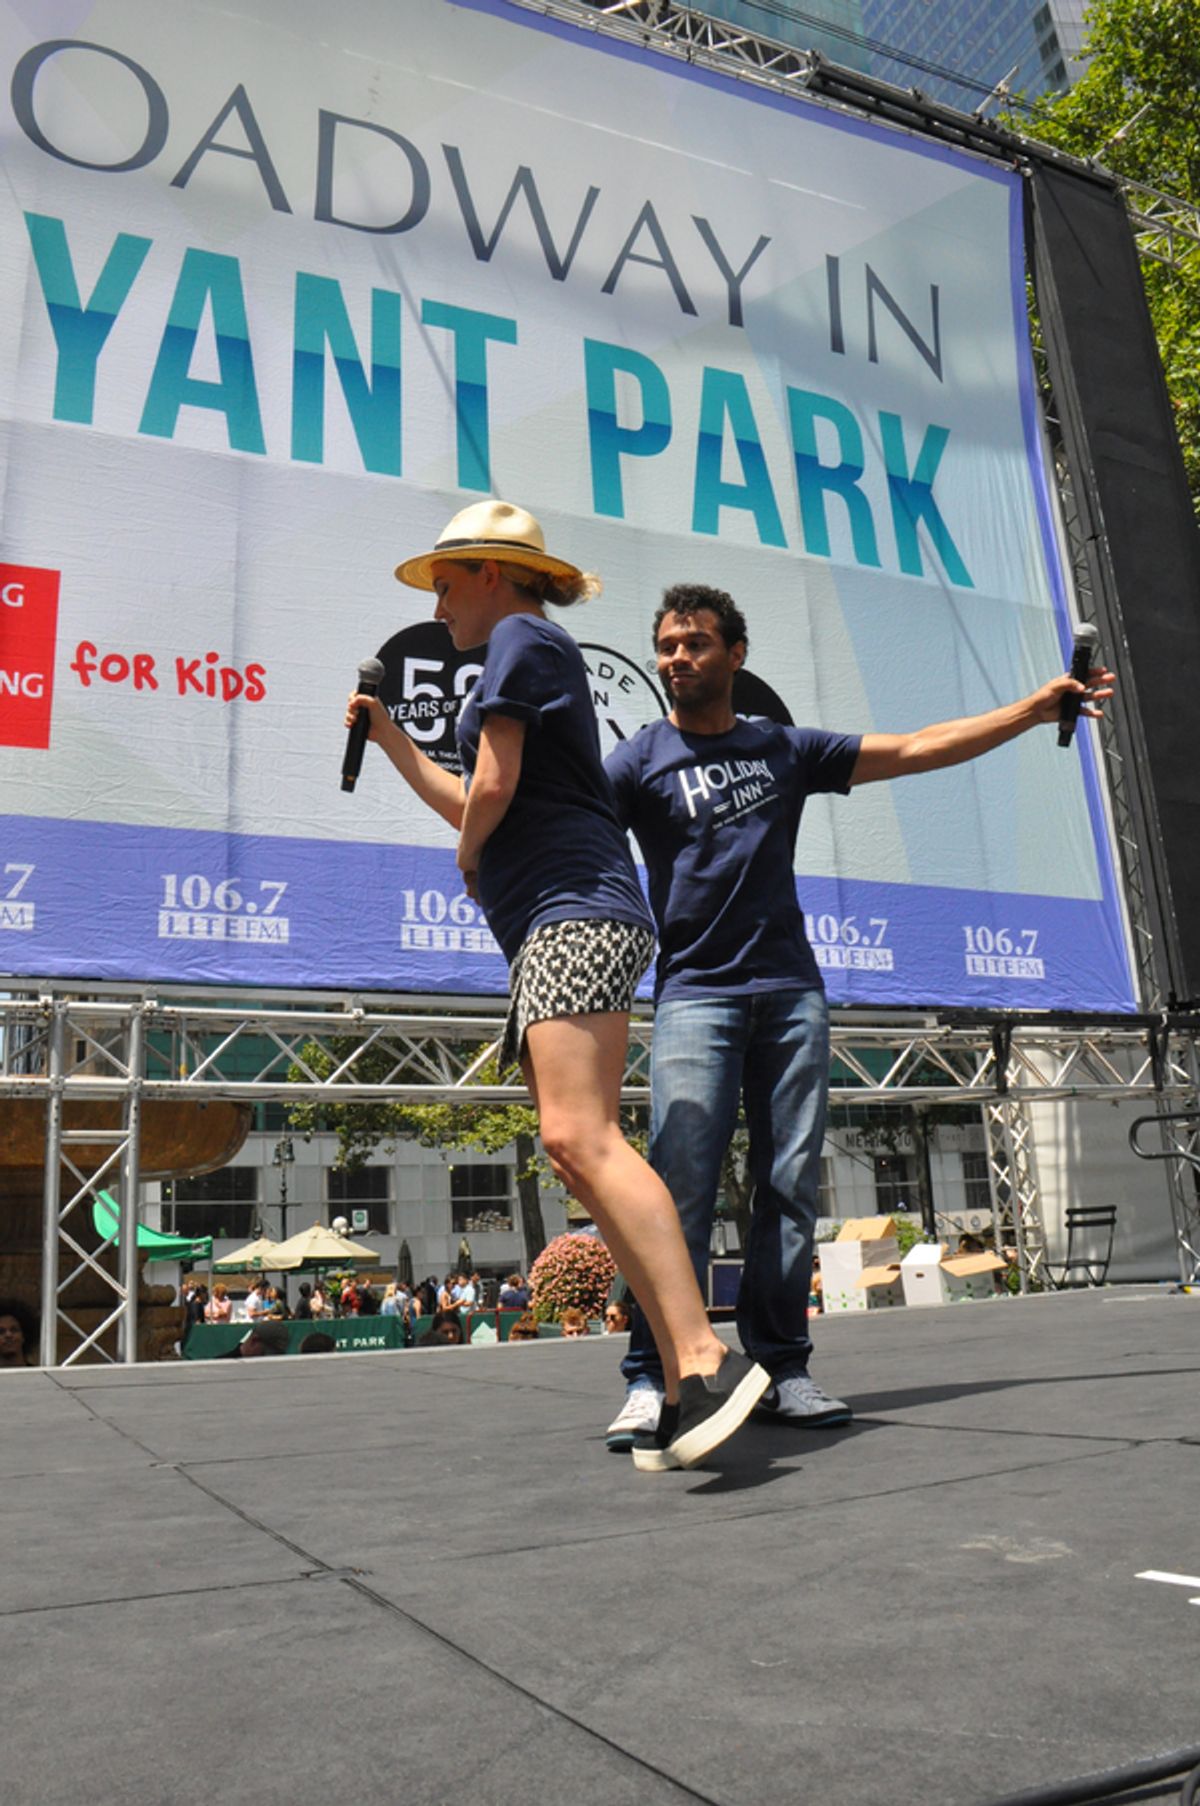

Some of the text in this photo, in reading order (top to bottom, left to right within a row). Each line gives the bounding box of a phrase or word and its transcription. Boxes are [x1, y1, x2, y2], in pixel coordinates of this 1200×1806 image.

[10, 39, 943, 384] OADWAY IN
[23, 210, 975, 589] YANT PARK
[175, 652, 267, 702] KiDS
[387, 700, 457, 721] YEARS OF
[678, 758, 775, 819] HOLIDAY
[732, 781, 764, 809] INN
[160, 874, 289, 915] 106.7
[400, 889, 489, 925] 106.
[804, 913, 889, 946] 106.7
[962, 925, 1039, 956] 106.7
[353, 1335, 385, 1348] PARK
